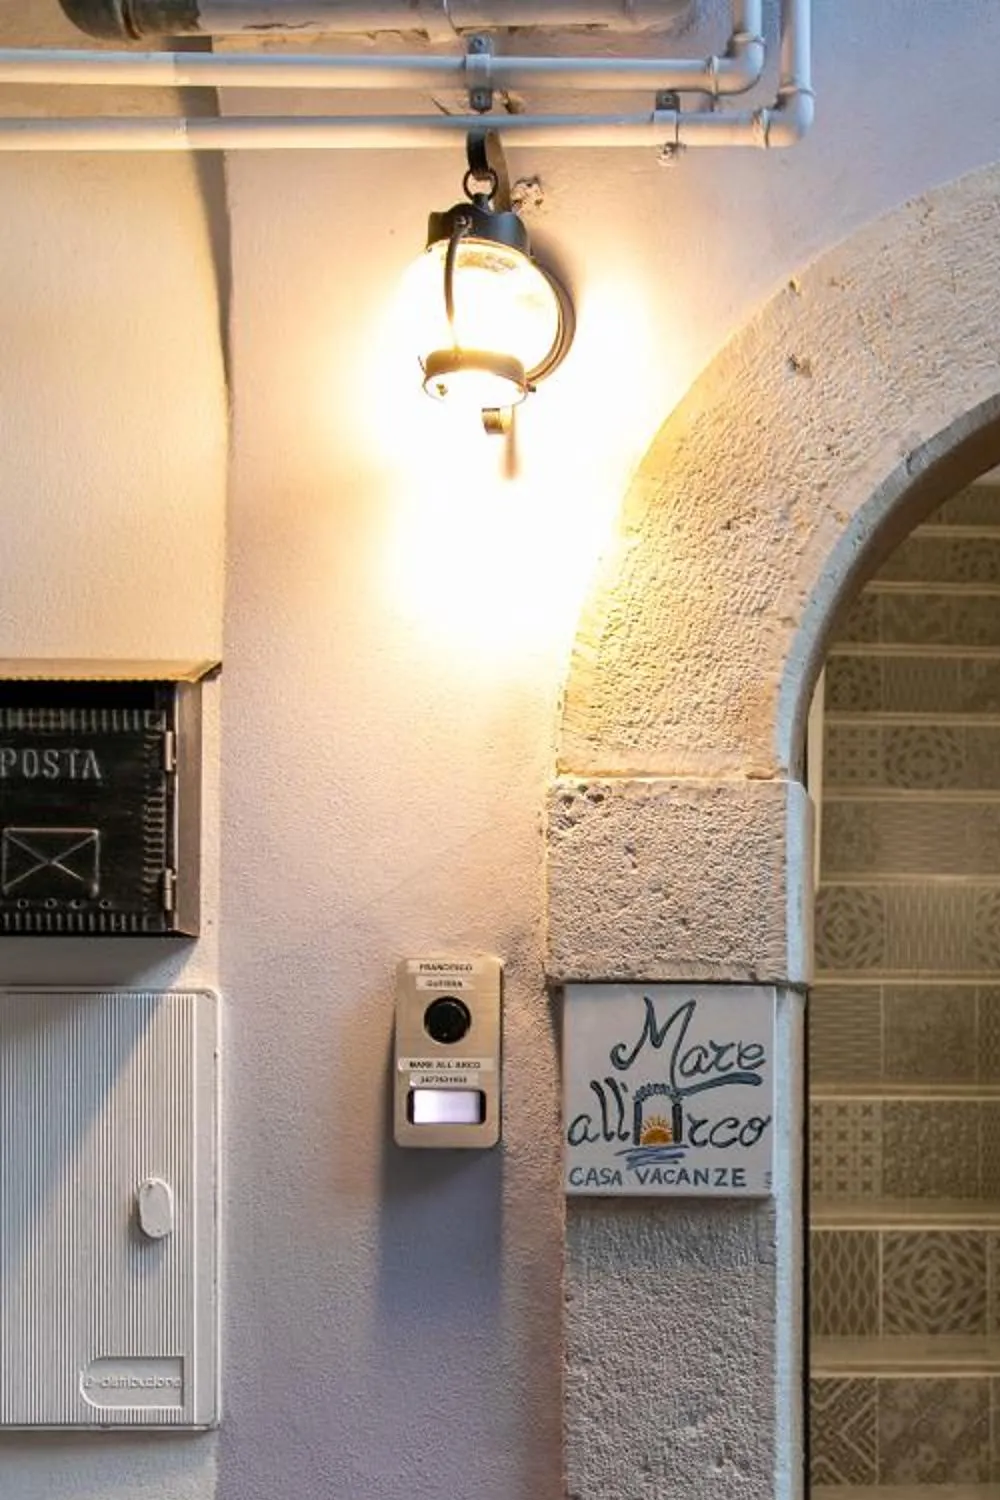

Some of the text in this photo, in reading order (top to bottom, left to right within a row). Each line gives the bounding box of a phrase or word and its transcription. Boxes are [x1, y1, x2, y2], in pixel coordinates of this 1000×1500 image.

[0, 747, 102, 780] POSTA
[610, 996, 767, 1092] Mare
[568, 1166, 624, 1187] CASA
[633, 1166, 748, 1188] VACANZE
